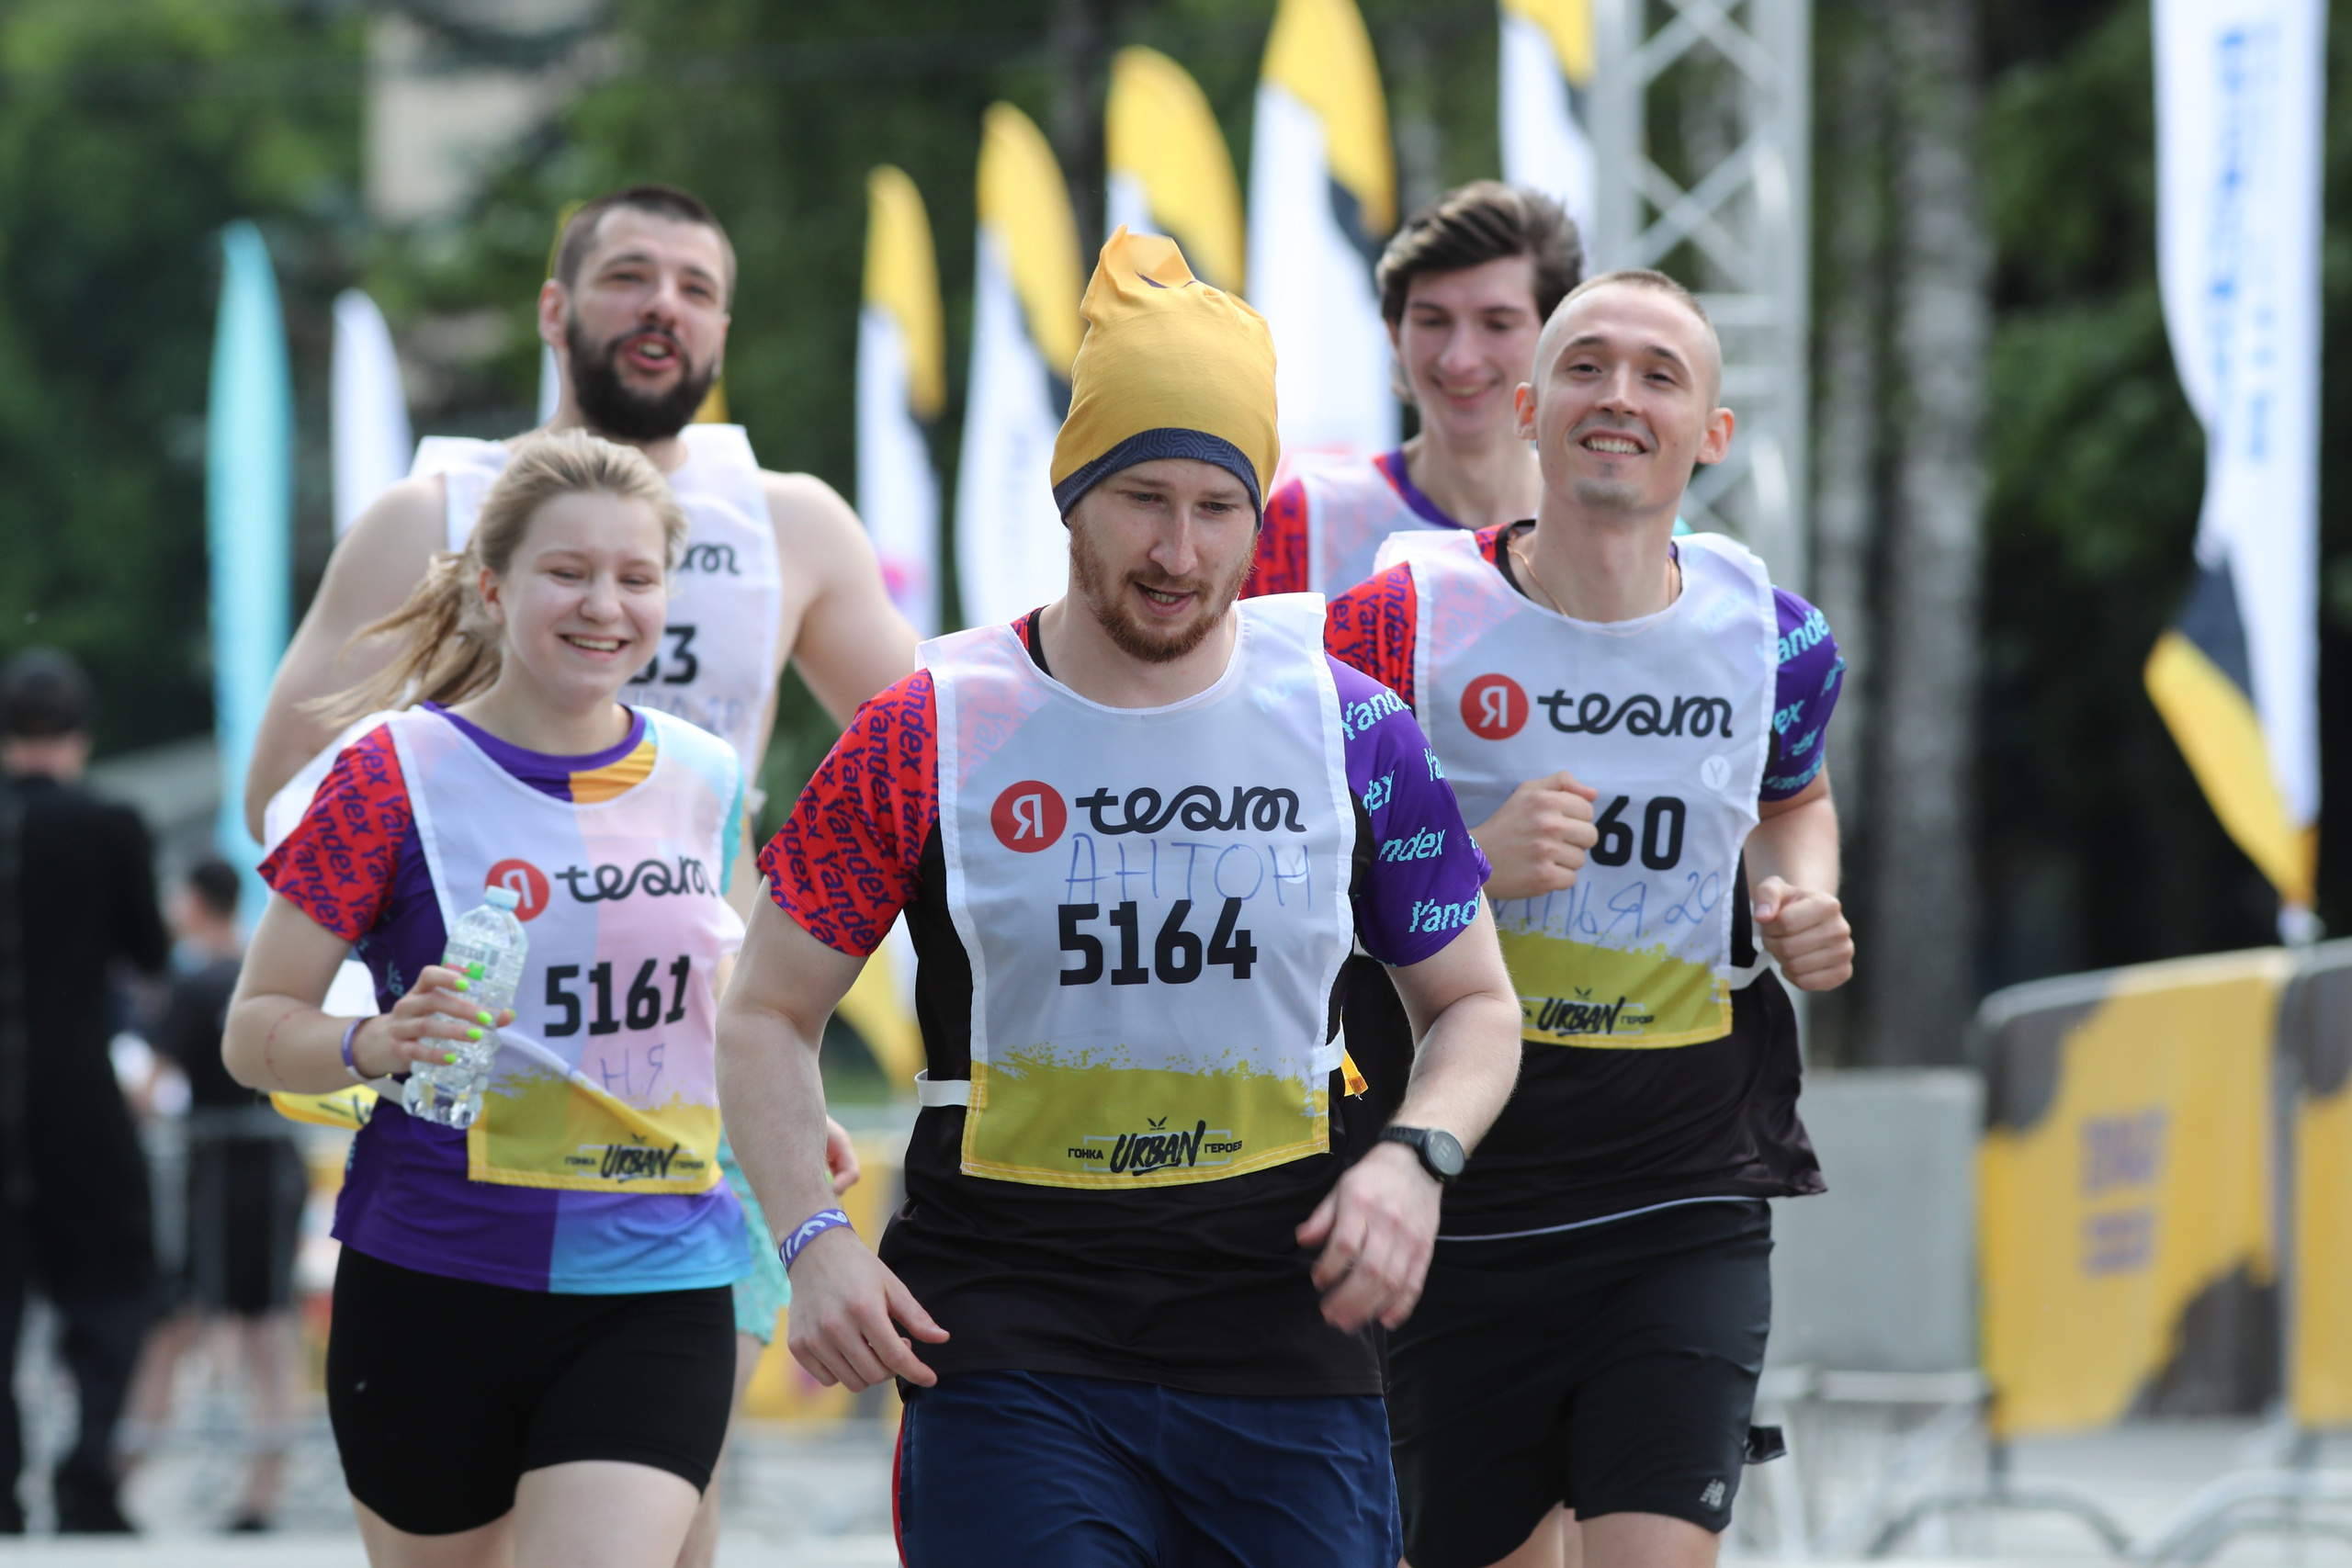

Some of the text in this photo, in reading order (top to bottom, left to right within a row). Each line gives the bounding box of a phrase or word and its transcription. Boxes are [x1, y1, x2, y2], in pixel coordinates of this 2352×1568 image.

[1778, 607, 1830, 665] ande
[1340, 687, 1412, 741] Yand
[1537, 689, 1733, 738] team
[1076, 786, 1306, 835] team
[1590, 795, 1686, 872] 60
[779, 818, 817, 896] ndex
[823, 797, 897, 910] Yandex
[1065, 832, 1312, 912] АНТОН
[1378, 827, 1446, 863] ndex
[554, 855, 716, 904] team
[1408, 891, 1480, 932] Yand
[1058, 897, 1258, 986] 5164
[544, 954, 690, 1037] 5161
[1538, 997, 1625, 1037] URBAN
[601, 1043, 665, 1097] НЯ
[601, 1142, 680, 1183] URBAN
[1068, 1147, 1104, 1160] ГОНКА
[1110, 1120, 1206, 1177] URBAN
